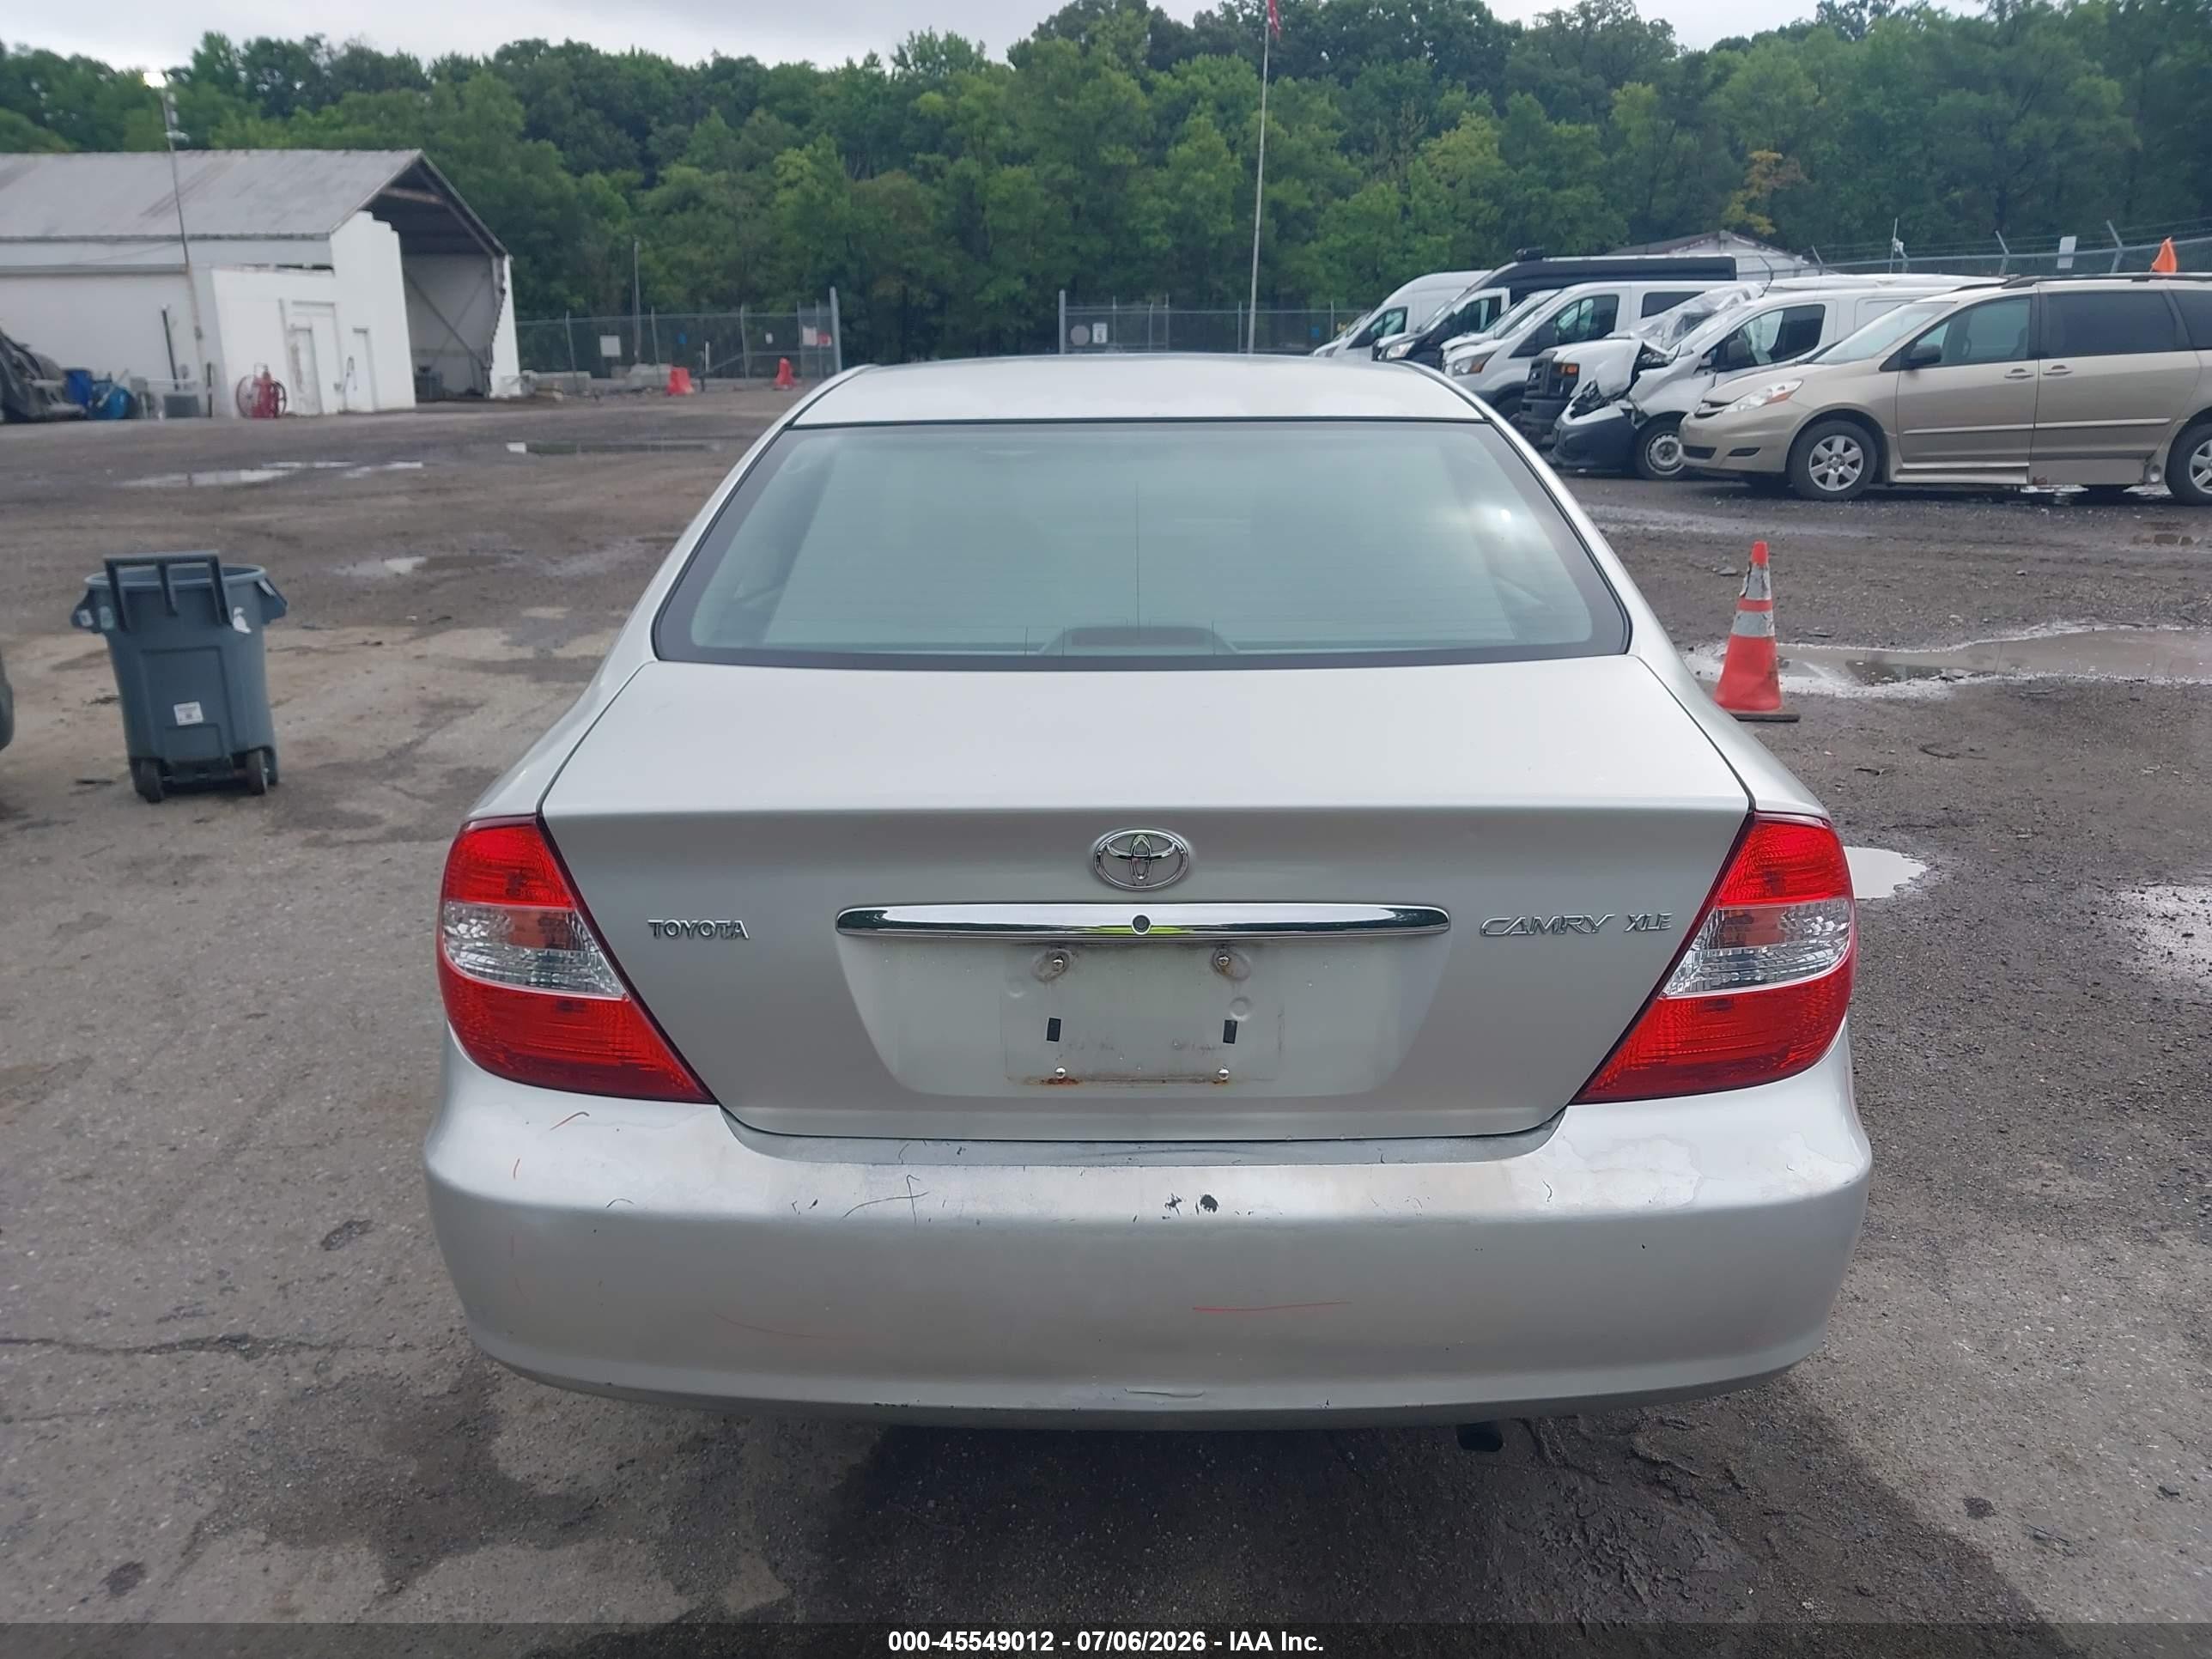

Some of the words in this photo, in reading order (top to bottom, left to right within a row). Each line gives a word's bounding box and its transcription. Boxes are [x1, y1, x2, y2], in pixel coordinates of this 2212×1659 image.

[647, 918, 750, 940] TOYOTA
[1480, 913, 1616, 936] CAMRY
[1624, 912, 1674, 933] XLE
